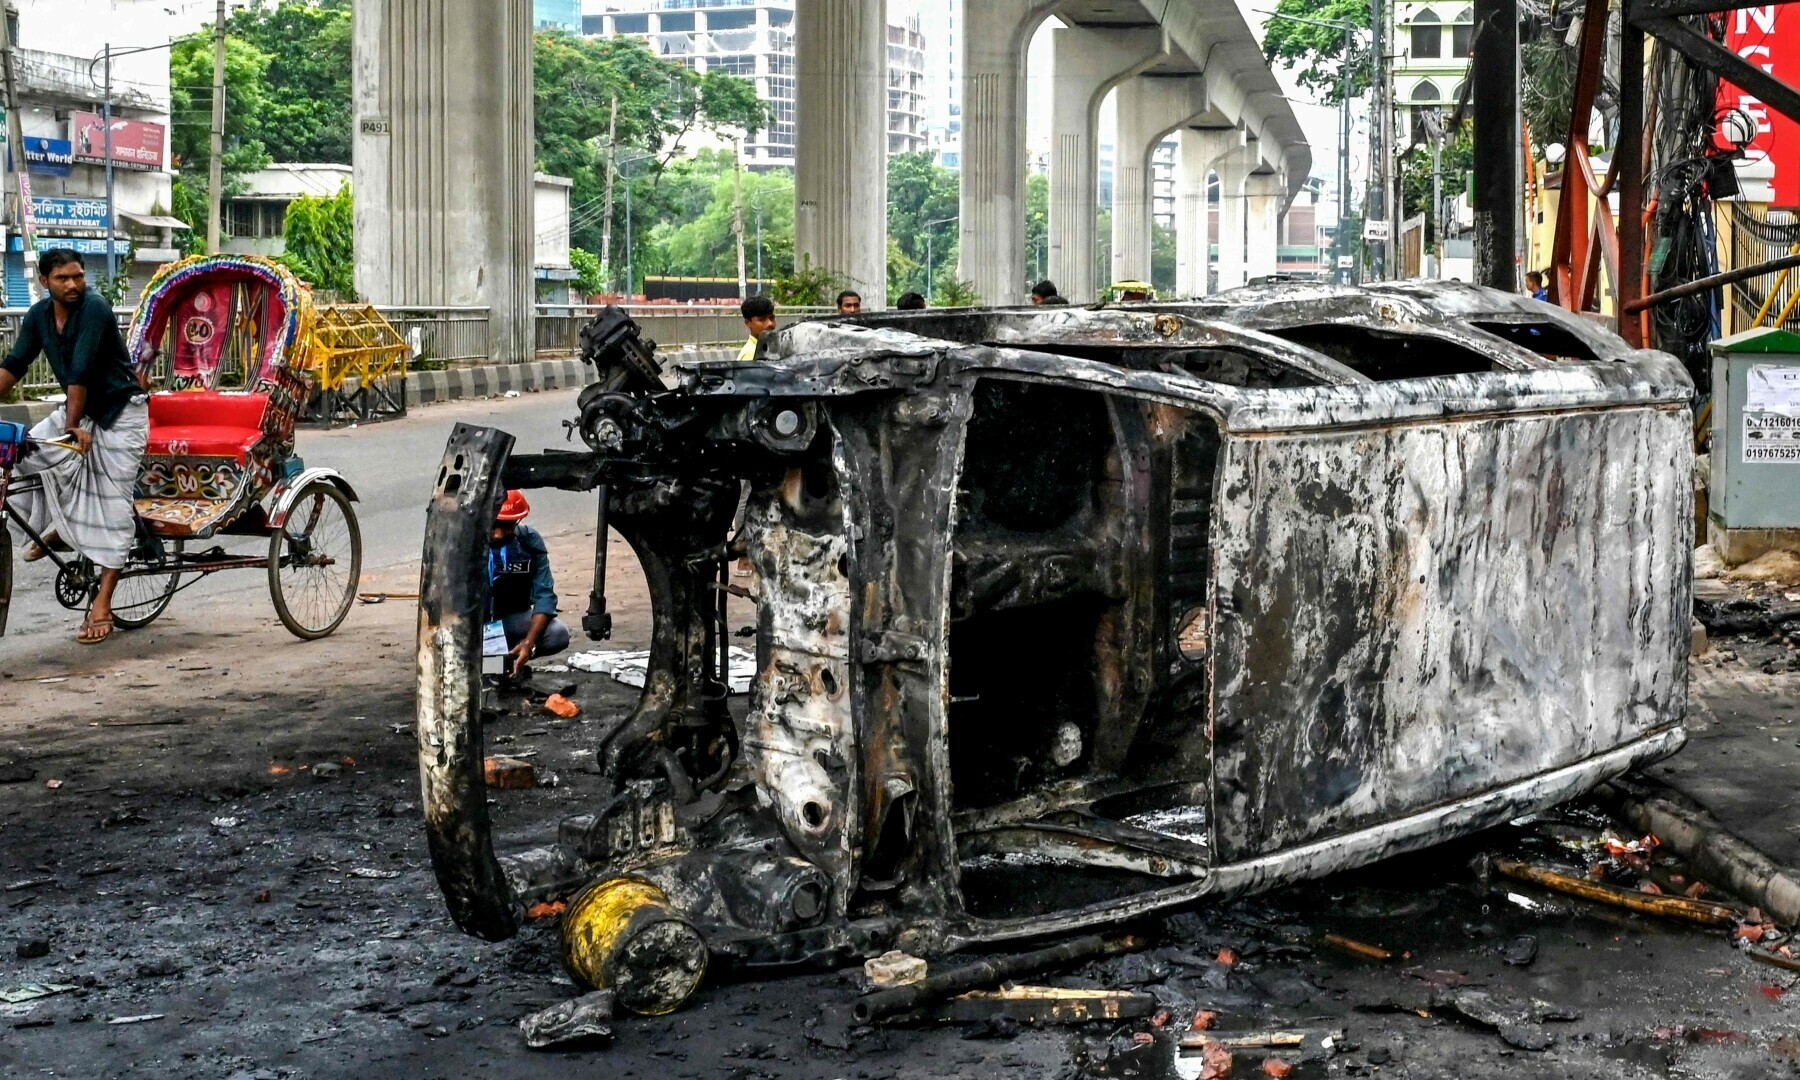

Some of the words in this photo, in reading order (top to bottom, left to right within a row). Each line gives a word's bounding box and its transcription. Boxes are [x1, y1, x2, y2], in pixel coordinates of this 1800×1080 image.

[362, 122, 389, 133] P491
[25, 150, 45, 161] tter
[47, 152, 73, 164] World
[33, 200, 65, 216] সলিম
[58, 218, 100, 226] SWEETMEAT
[1746, 449, 1800, 458] 0197675257
